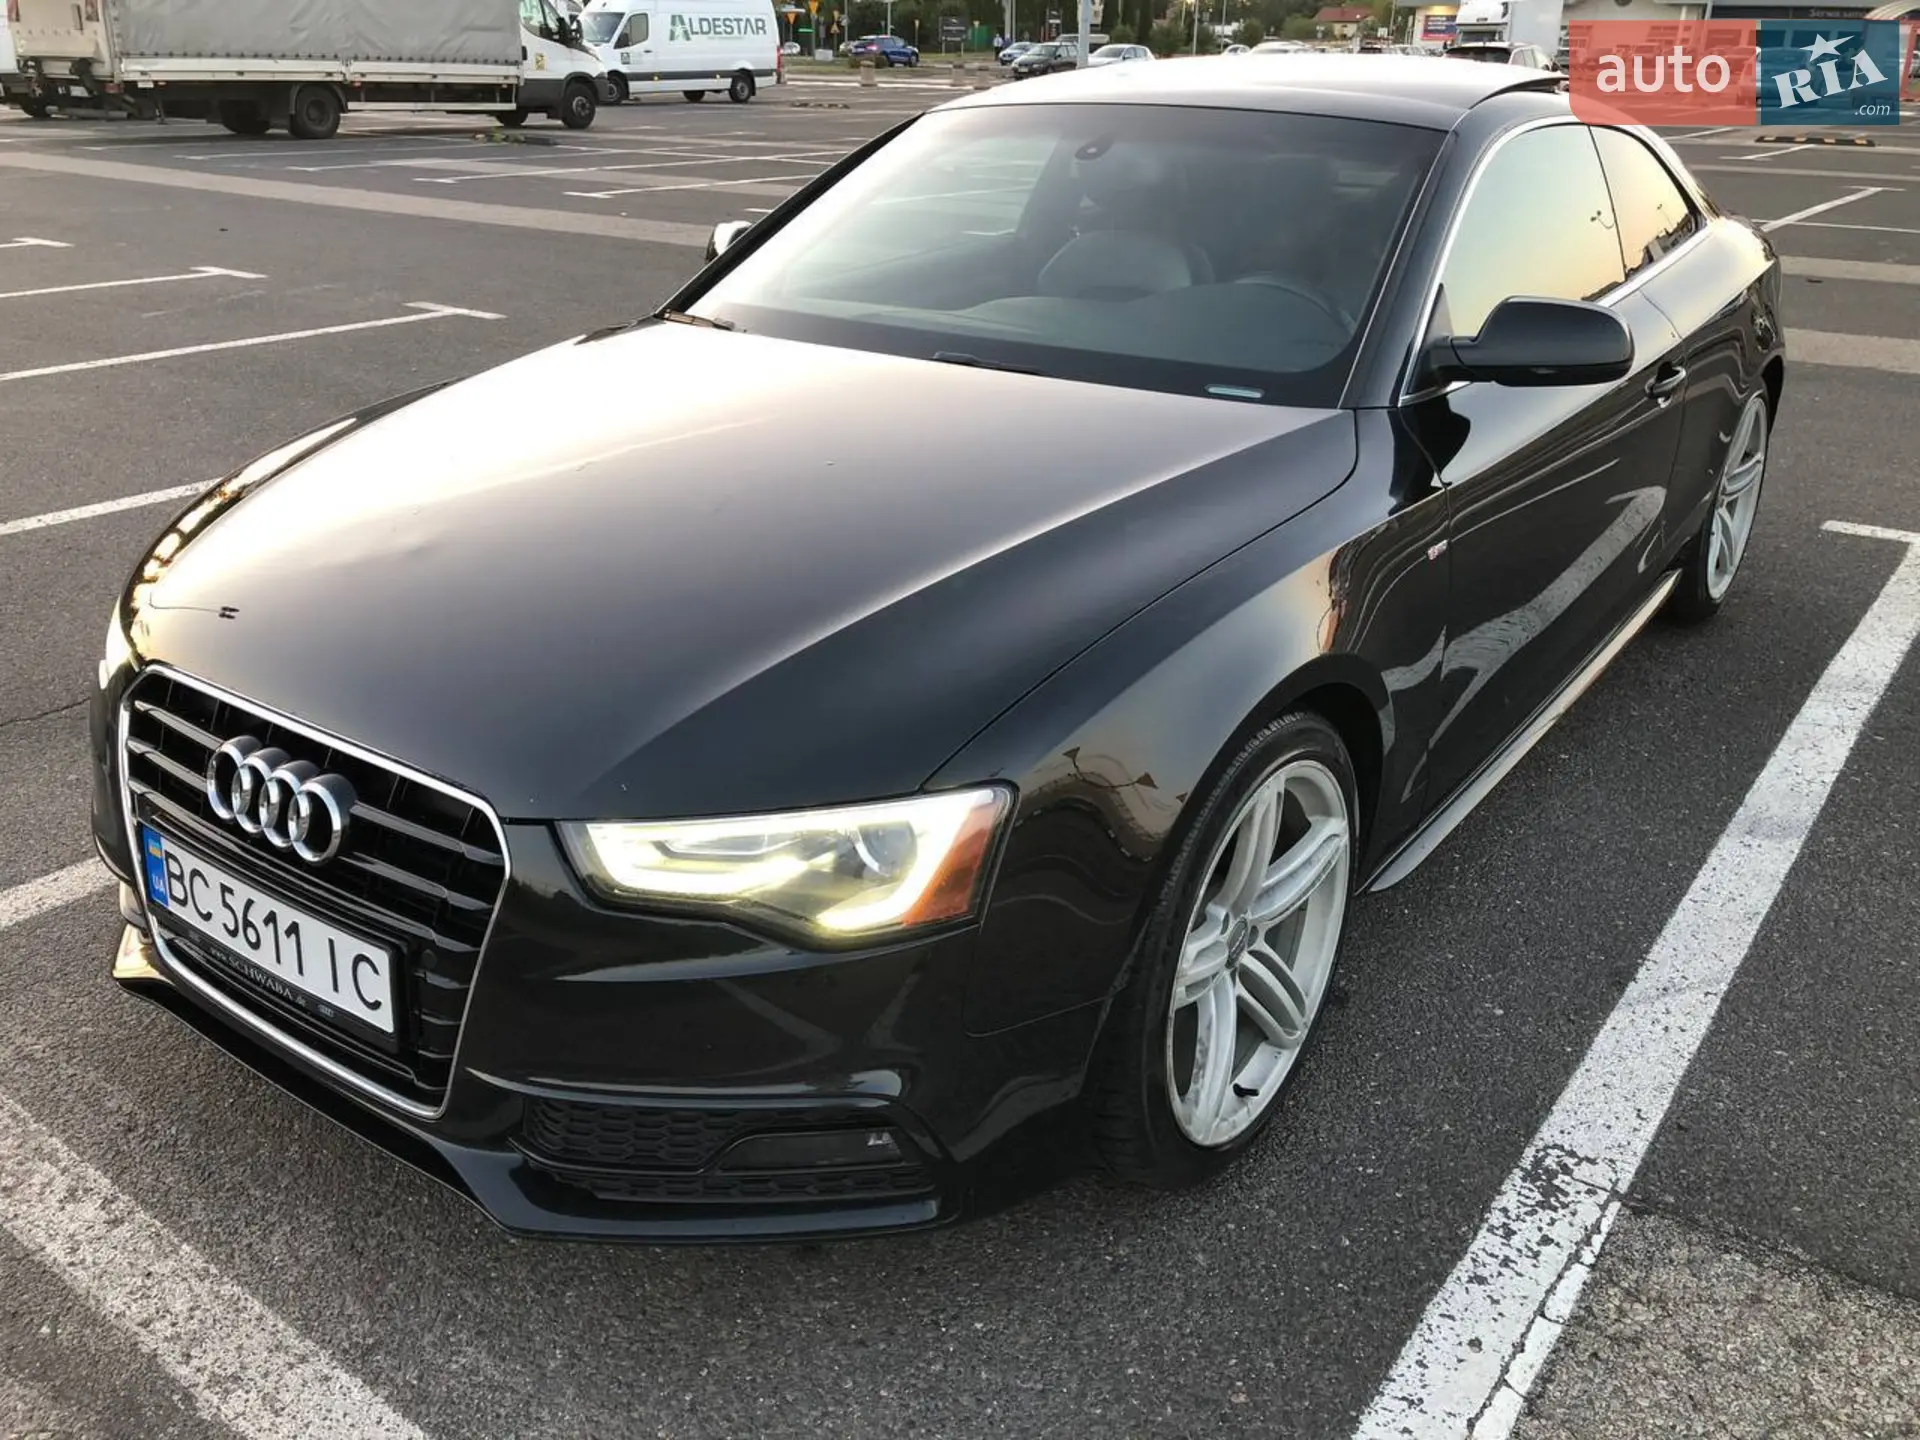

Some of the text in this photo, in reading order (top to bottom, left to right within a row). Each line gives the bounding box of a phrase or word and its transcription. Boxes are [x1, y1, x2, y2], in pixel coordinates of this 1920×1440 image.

[669, 14, 767, 41] ALDESTAR
[164, 849, 383, 1011] BC 5611 IC
